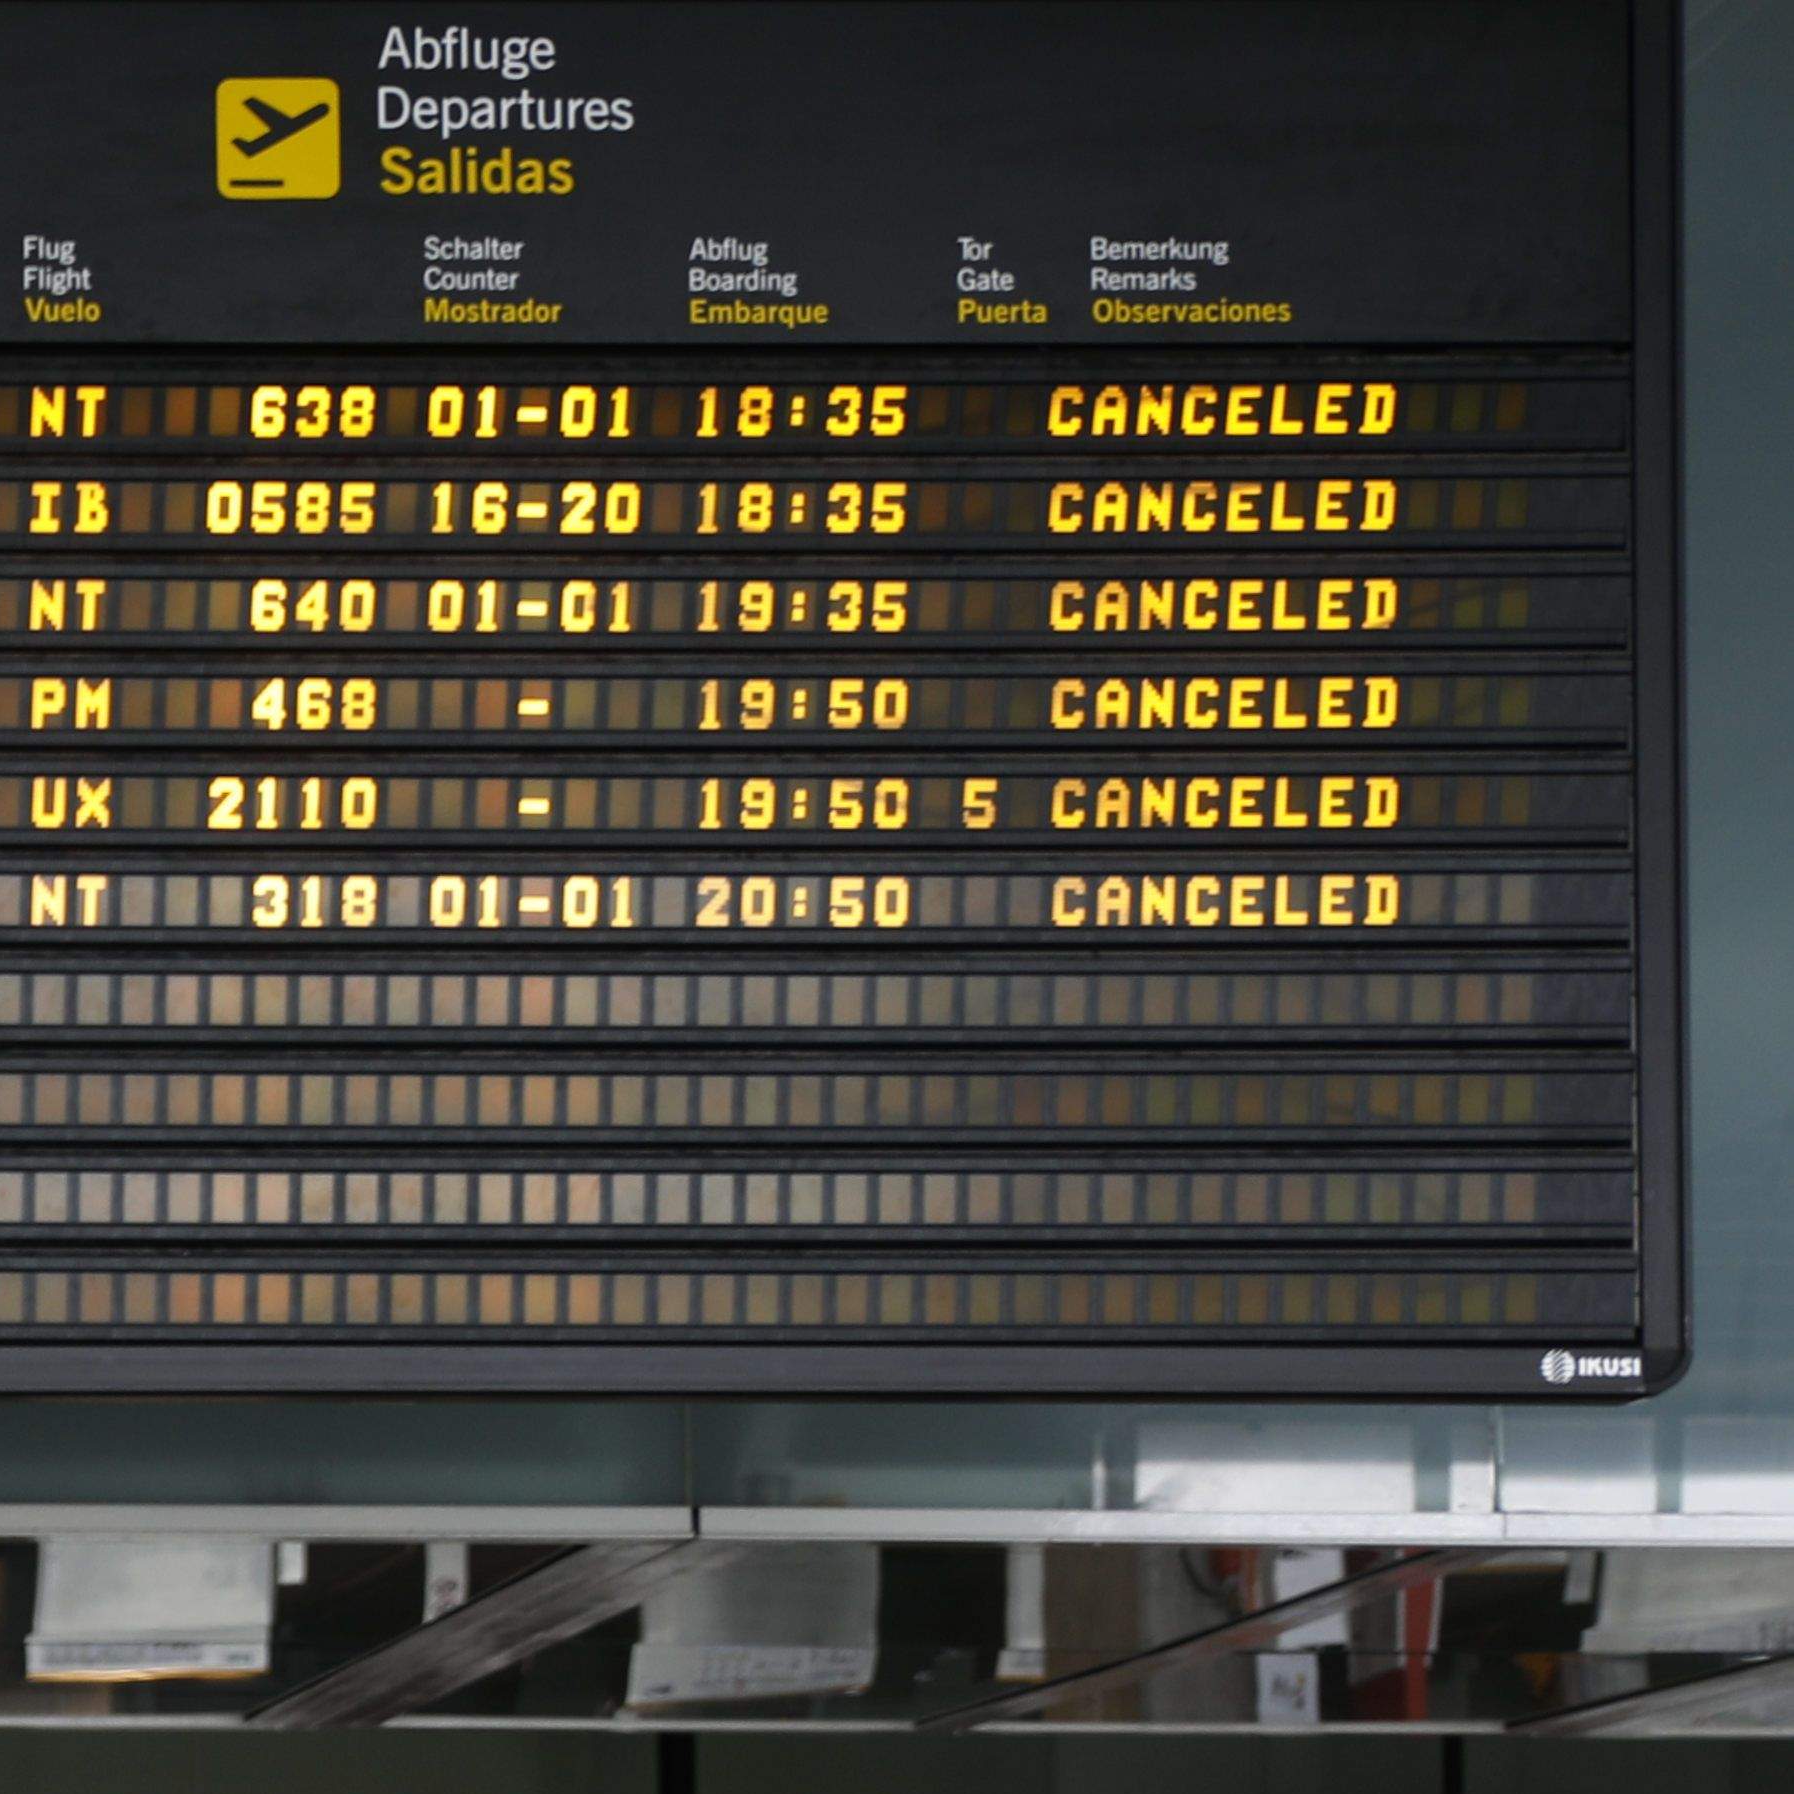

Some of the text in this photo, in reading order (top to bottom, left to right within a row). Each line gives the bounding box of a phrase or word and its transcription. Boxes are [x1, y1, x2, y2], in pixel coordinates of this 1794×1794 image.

[377, 24, 556, 81] Abfluge
[376, 85, 636, 141] Departures
[379, 145, 576, 196] Salidas
[23, 235, 76, 266] Flug
[424, 234, 525, 260] Schalter
[689, 236, 769, 264] Abflug
[957, 236, 993, 262] Tor
[1090, 235, 1230, 265] Bemerkung
[23, 265, 92, 296] Flight
[423, 265, 519, 292] Counter
[688, 268, 798, 296] Boarding
[956, 267, 1015, 292] Gate
[1090, 267, 1197, 292] Remarks
[25, 298, 102, 323] Vuelo
[424, 297, 563, 324] Mostrador
[689, 299, 829, 329] Embarque
[957, 298, 1048, 325] Puerta
[1092, 298, 1293, 325] Observaciones
[30, 387, 105, 437] NT
[250, 386, 375, 438] 638
[427, 386, 629, 437] 01-01
[696, 387, 905, 437] 18:35
[1048, 384, 1395, 436] CANCELED
[29, 483, 108, 533] IB
[206, 482, 375, 533] 0585
[432, 482, 640, 534] 16-20
[698, 483, 905, 533] 18:35
[1048, 481, 1395, 532] CANCELED
[29, 580, 105, 630] NT
[250, 580, 375, 632] 640
[427, 580, 630, 632] 01-01
[698, 582, 906, 632] 19:35
[1049, 580, 1396, 631] CANCELED
[31, 778, 110, 828] UX
[207, 777, 376, 829] 2110
[700, 780, 908, 829] 19:50
[963, 779, 997, 828] 5
[1051, 778, 1398, 828] CANCELED
[30, 876, 107, 926] NT
[252, 875, 377, 927] 318
[429, 876, 632, 928] 01-01
[696, 877, 908, 927] 20:50
[1052, 876, 1398, 926] CANCELED
[1577, 1356, 1642, 1377] IKUSI
